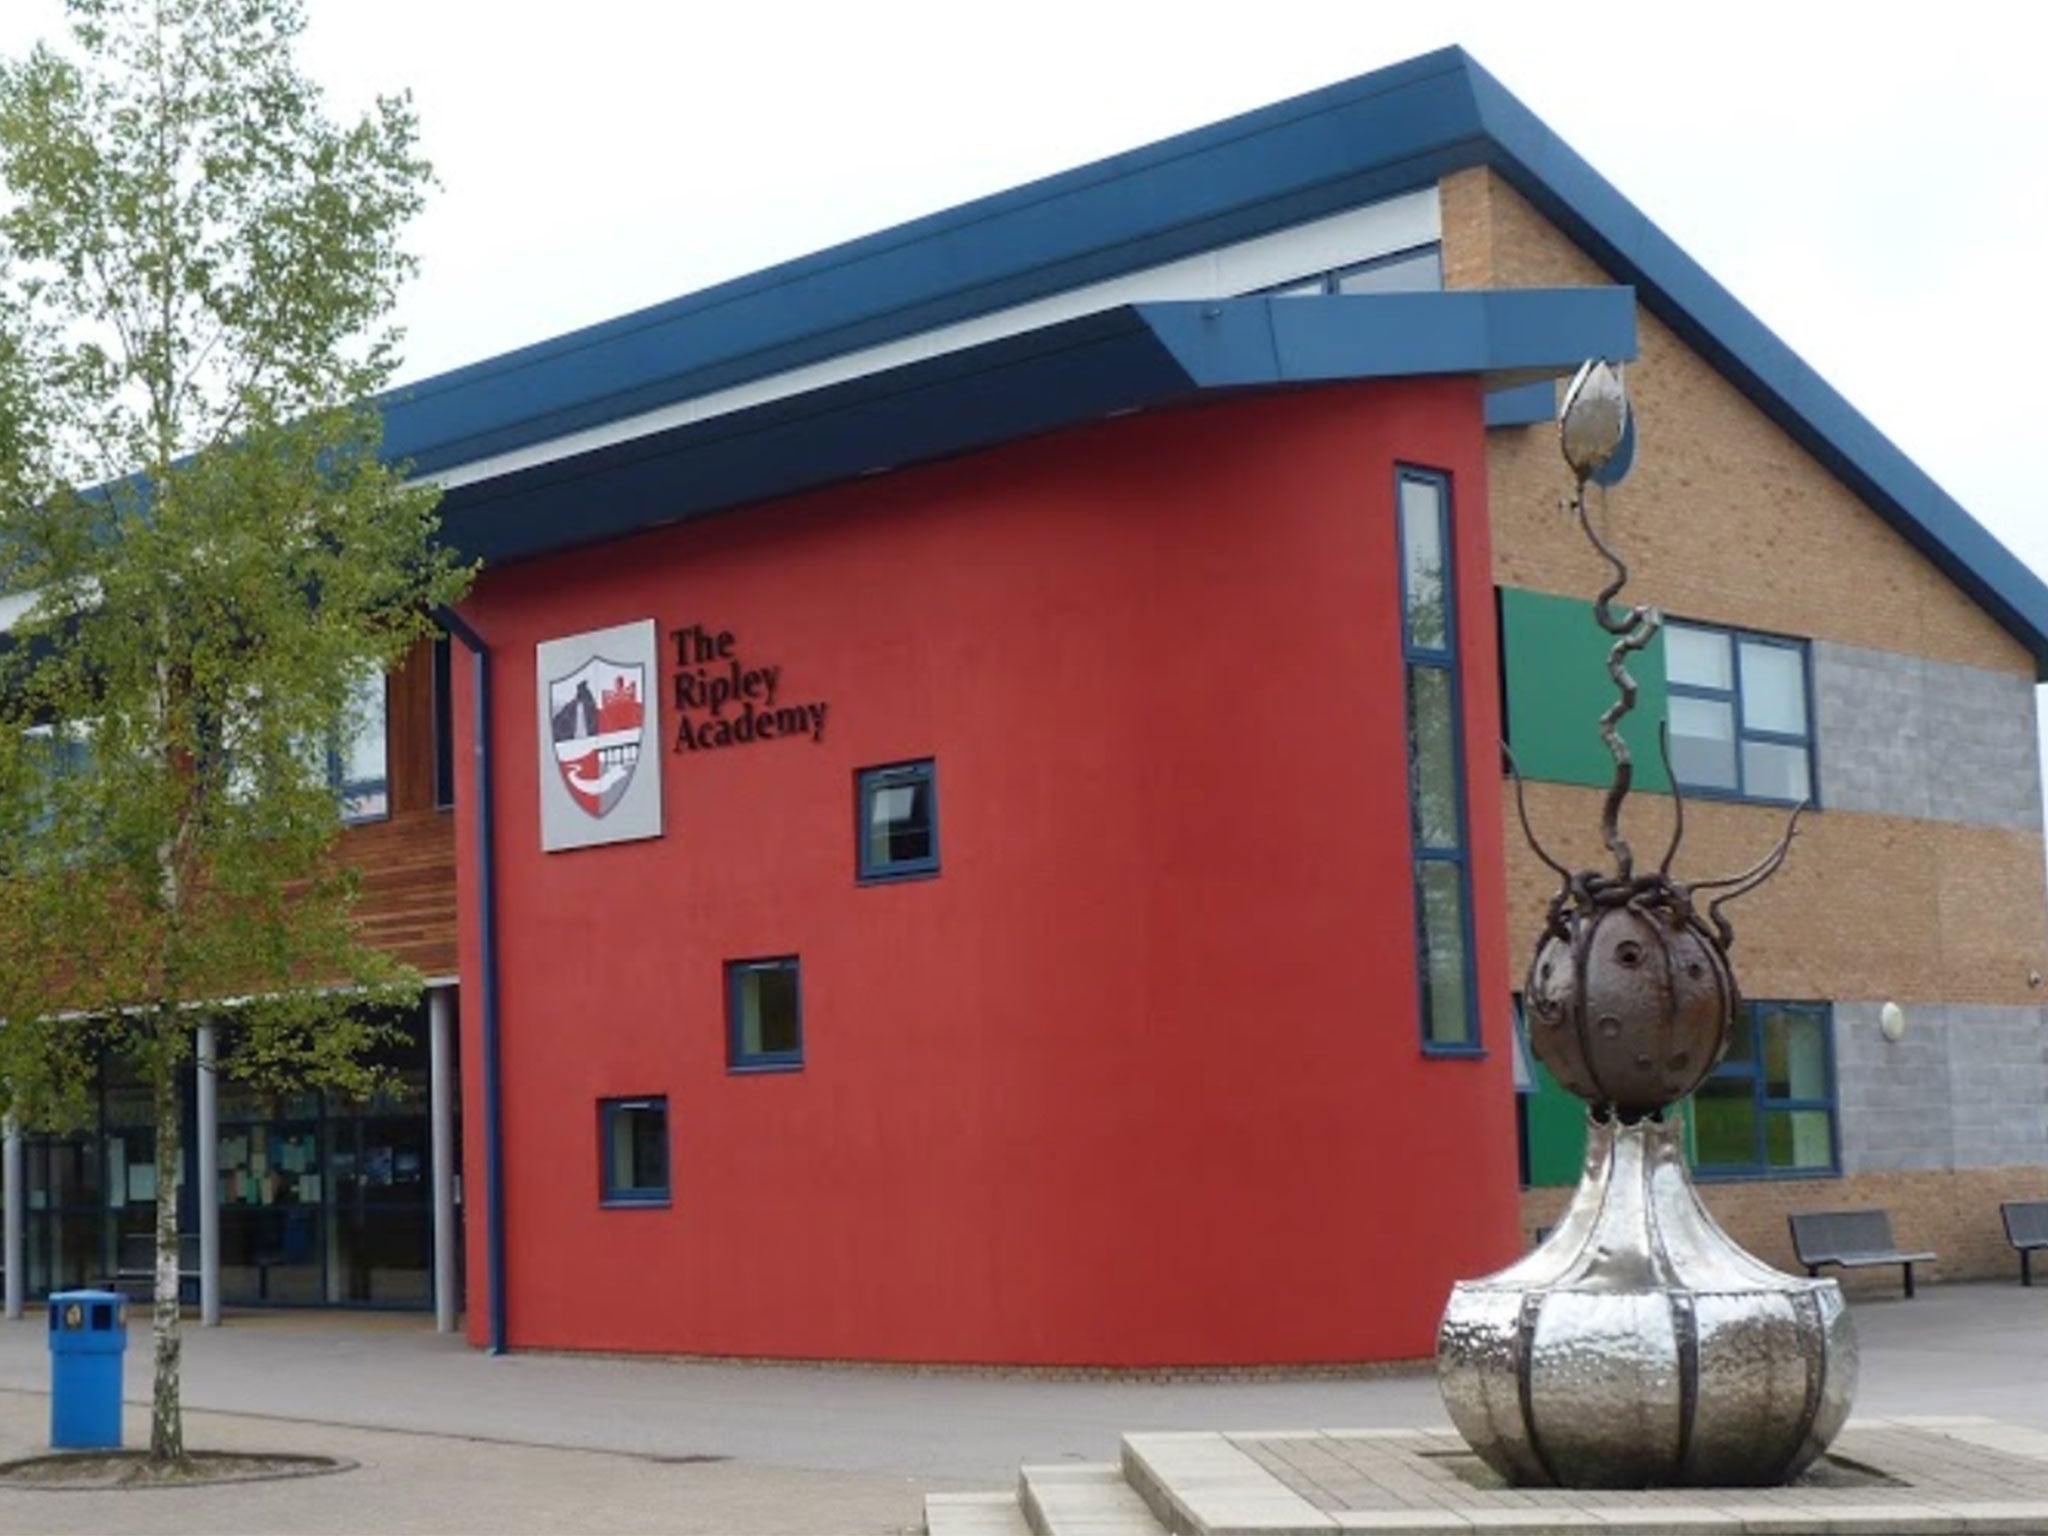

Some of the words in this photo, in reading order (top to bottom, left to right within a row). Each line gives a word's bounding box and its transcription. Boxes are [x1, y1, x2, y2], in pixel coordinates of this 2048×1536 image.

[671, 624, 735, 666] The
[674, 660, 778, 715] Ripley
[674, 702, 827, 753] Academy
